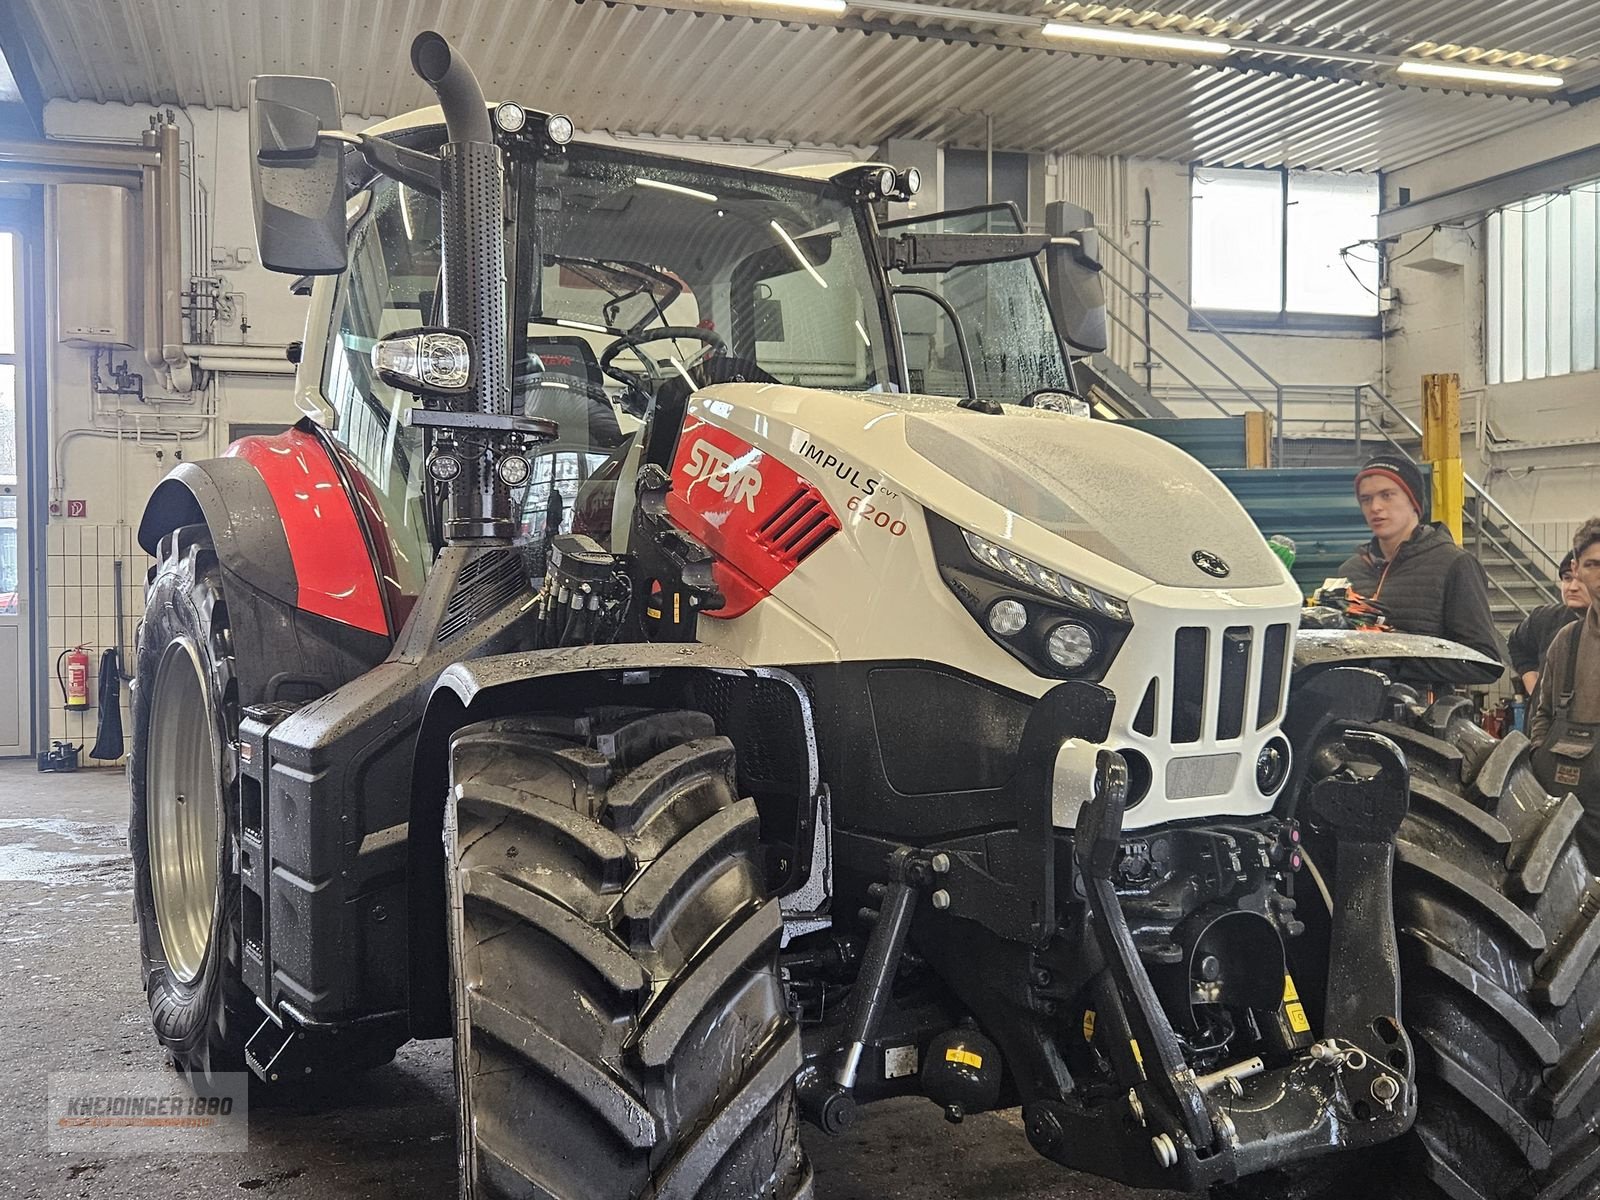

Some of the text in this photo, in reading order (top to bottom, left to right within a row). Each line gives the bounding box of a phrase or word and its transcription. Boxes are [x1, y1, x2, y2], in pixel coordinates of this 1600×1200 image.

[682, 438, 763, 513] STEYR
[798, 440, 899, 499] IMPULS CVT
[846, 495, 908, 537] 6200
